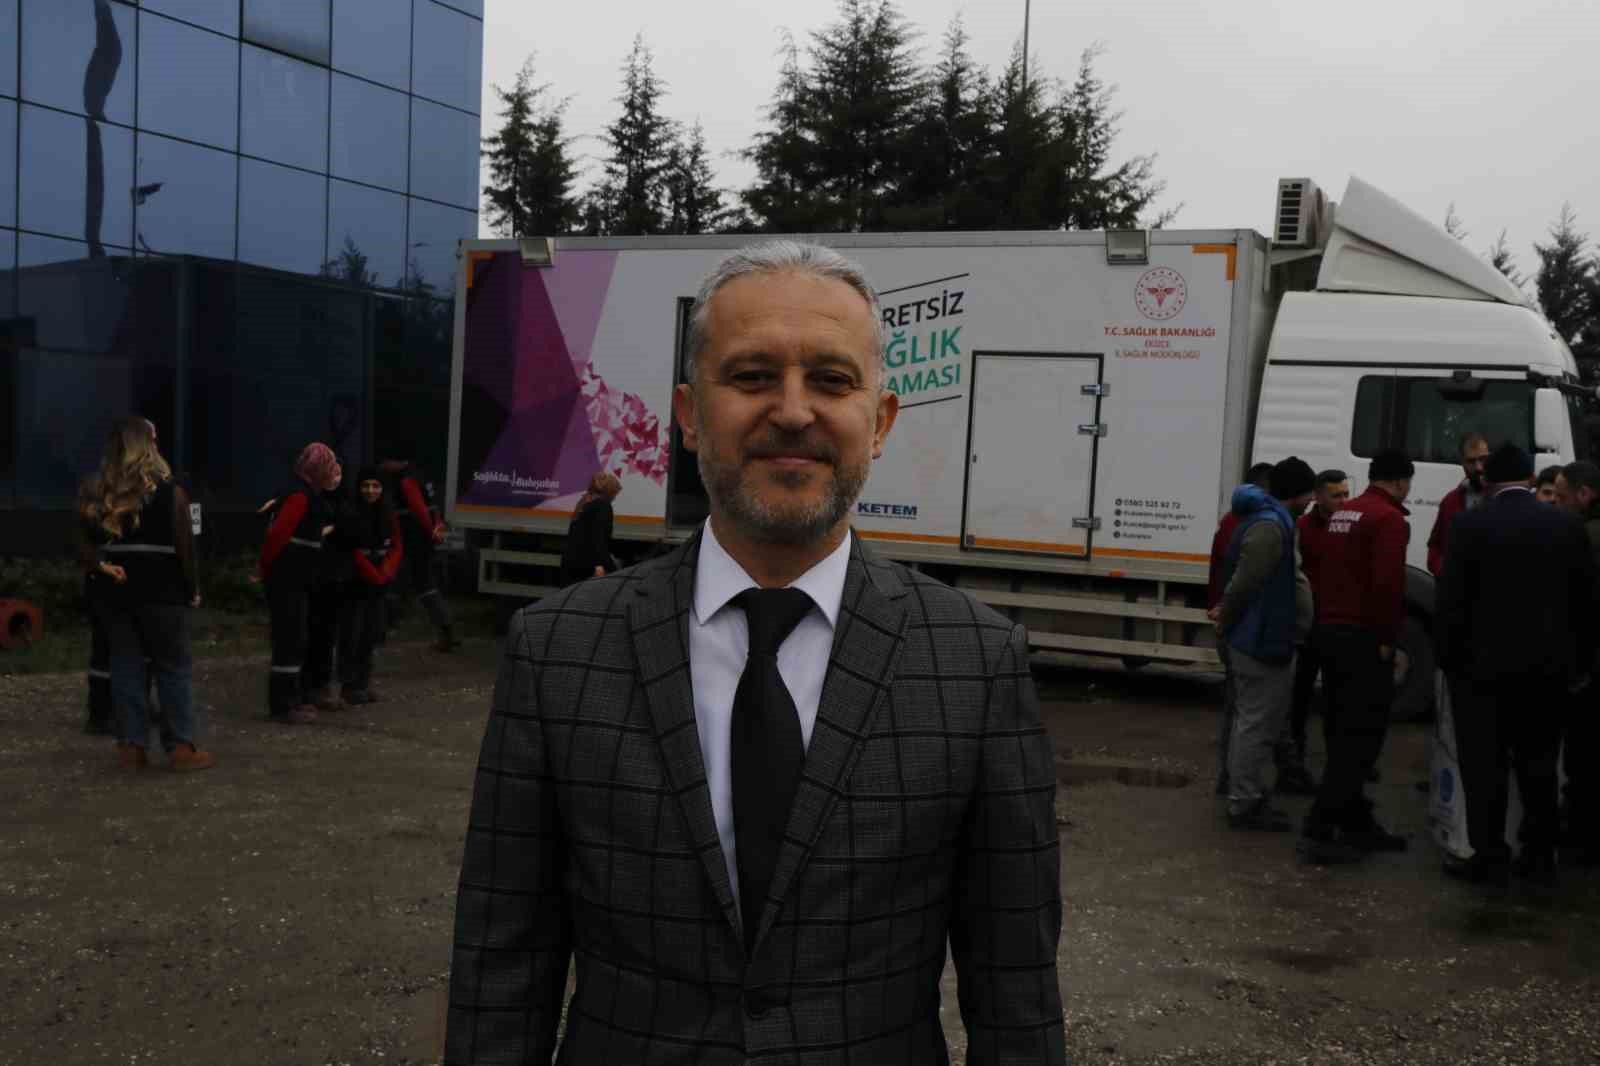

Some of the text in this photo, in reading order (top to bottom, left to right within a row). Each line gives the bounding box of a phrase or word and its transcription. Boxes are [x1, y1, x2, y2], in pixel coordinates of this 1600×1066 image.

[881, 289, 965, 328] RETSİZ
[885, 326, 963, 369] ĞLIK
[1121, 325, 1158, 337] SAĞLIK
[887, 363, 962, 396] AMASI
[858, 502, 918, 516] KETEM
